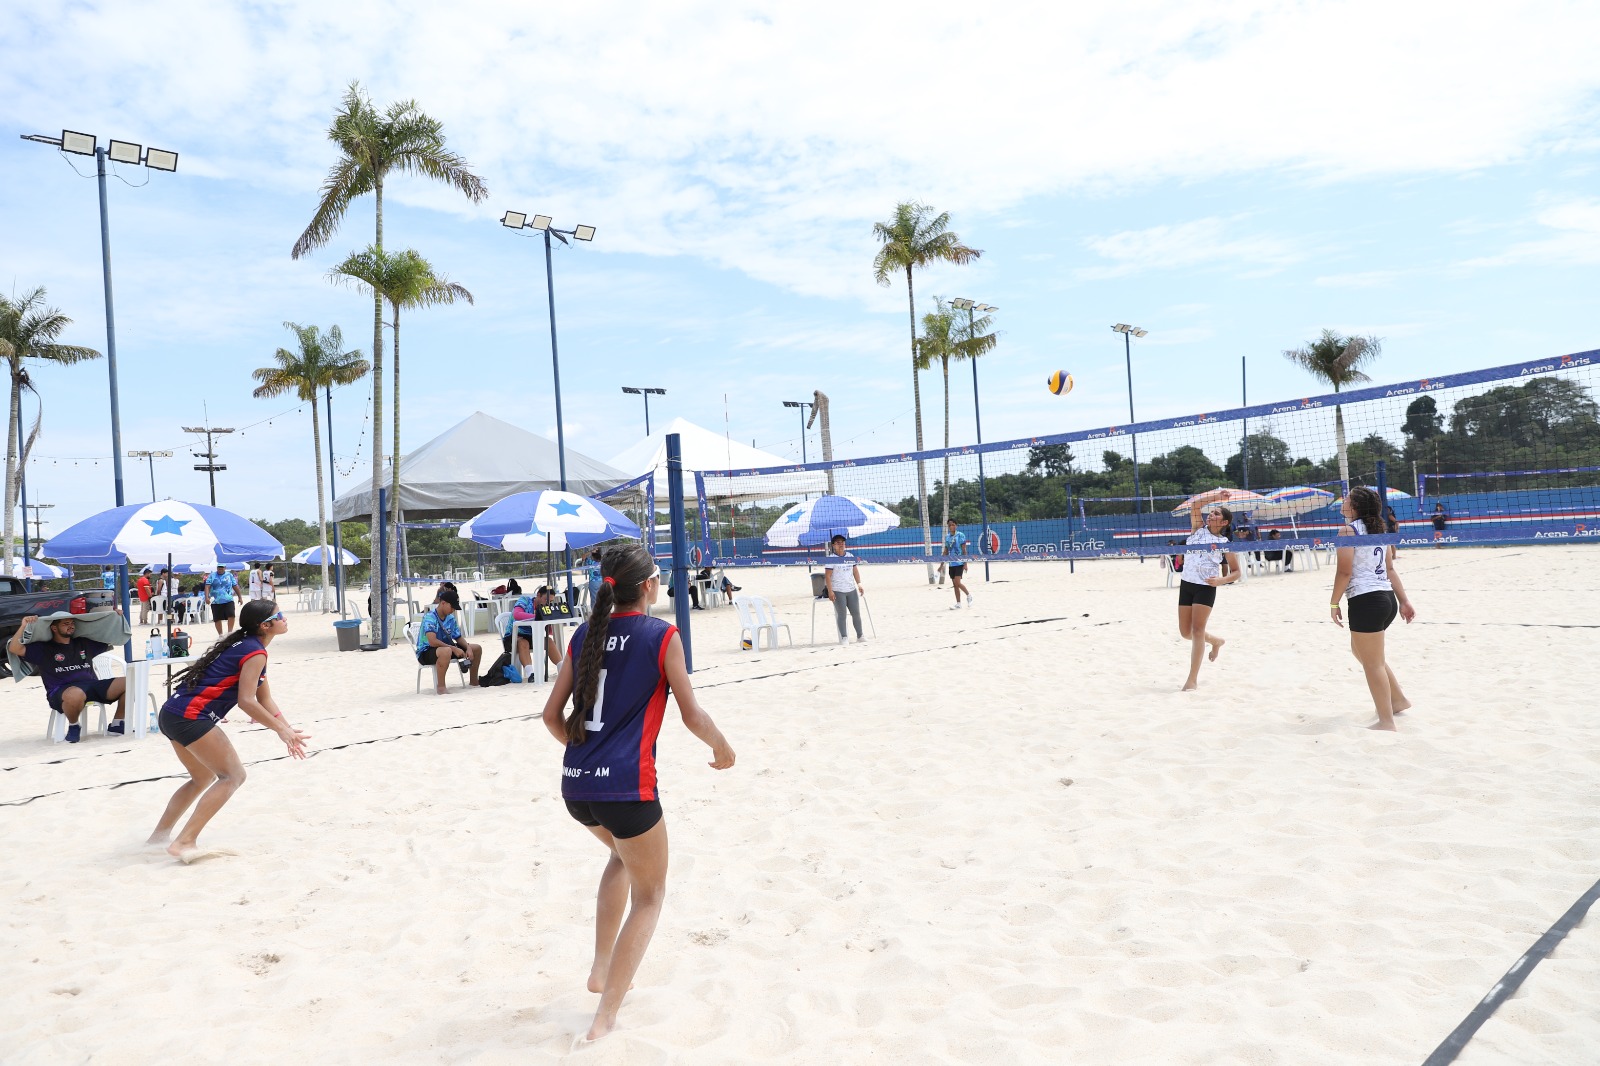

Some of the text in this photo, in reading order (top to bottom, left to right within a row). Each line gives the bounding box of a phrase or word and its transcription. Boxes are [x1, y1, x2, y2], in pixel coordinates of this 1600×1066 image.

[1520, 364, 1555, 376] Arena
[1385, 387, 1415, 397] Arena
[1272, 404, 1297, 414] Arena
[1173, 419, 1195, 428] Arena
[1535, 531, 1569, 539] Arena
[1373, 546, 1385, 575] 2
[541, 605, 552, 615] 15
[560, 604, 569, 614] 6
[606, 634, 631, 651] BY
[584, 668, 608, 732] 1
[595, 766, 610, 777] AM
